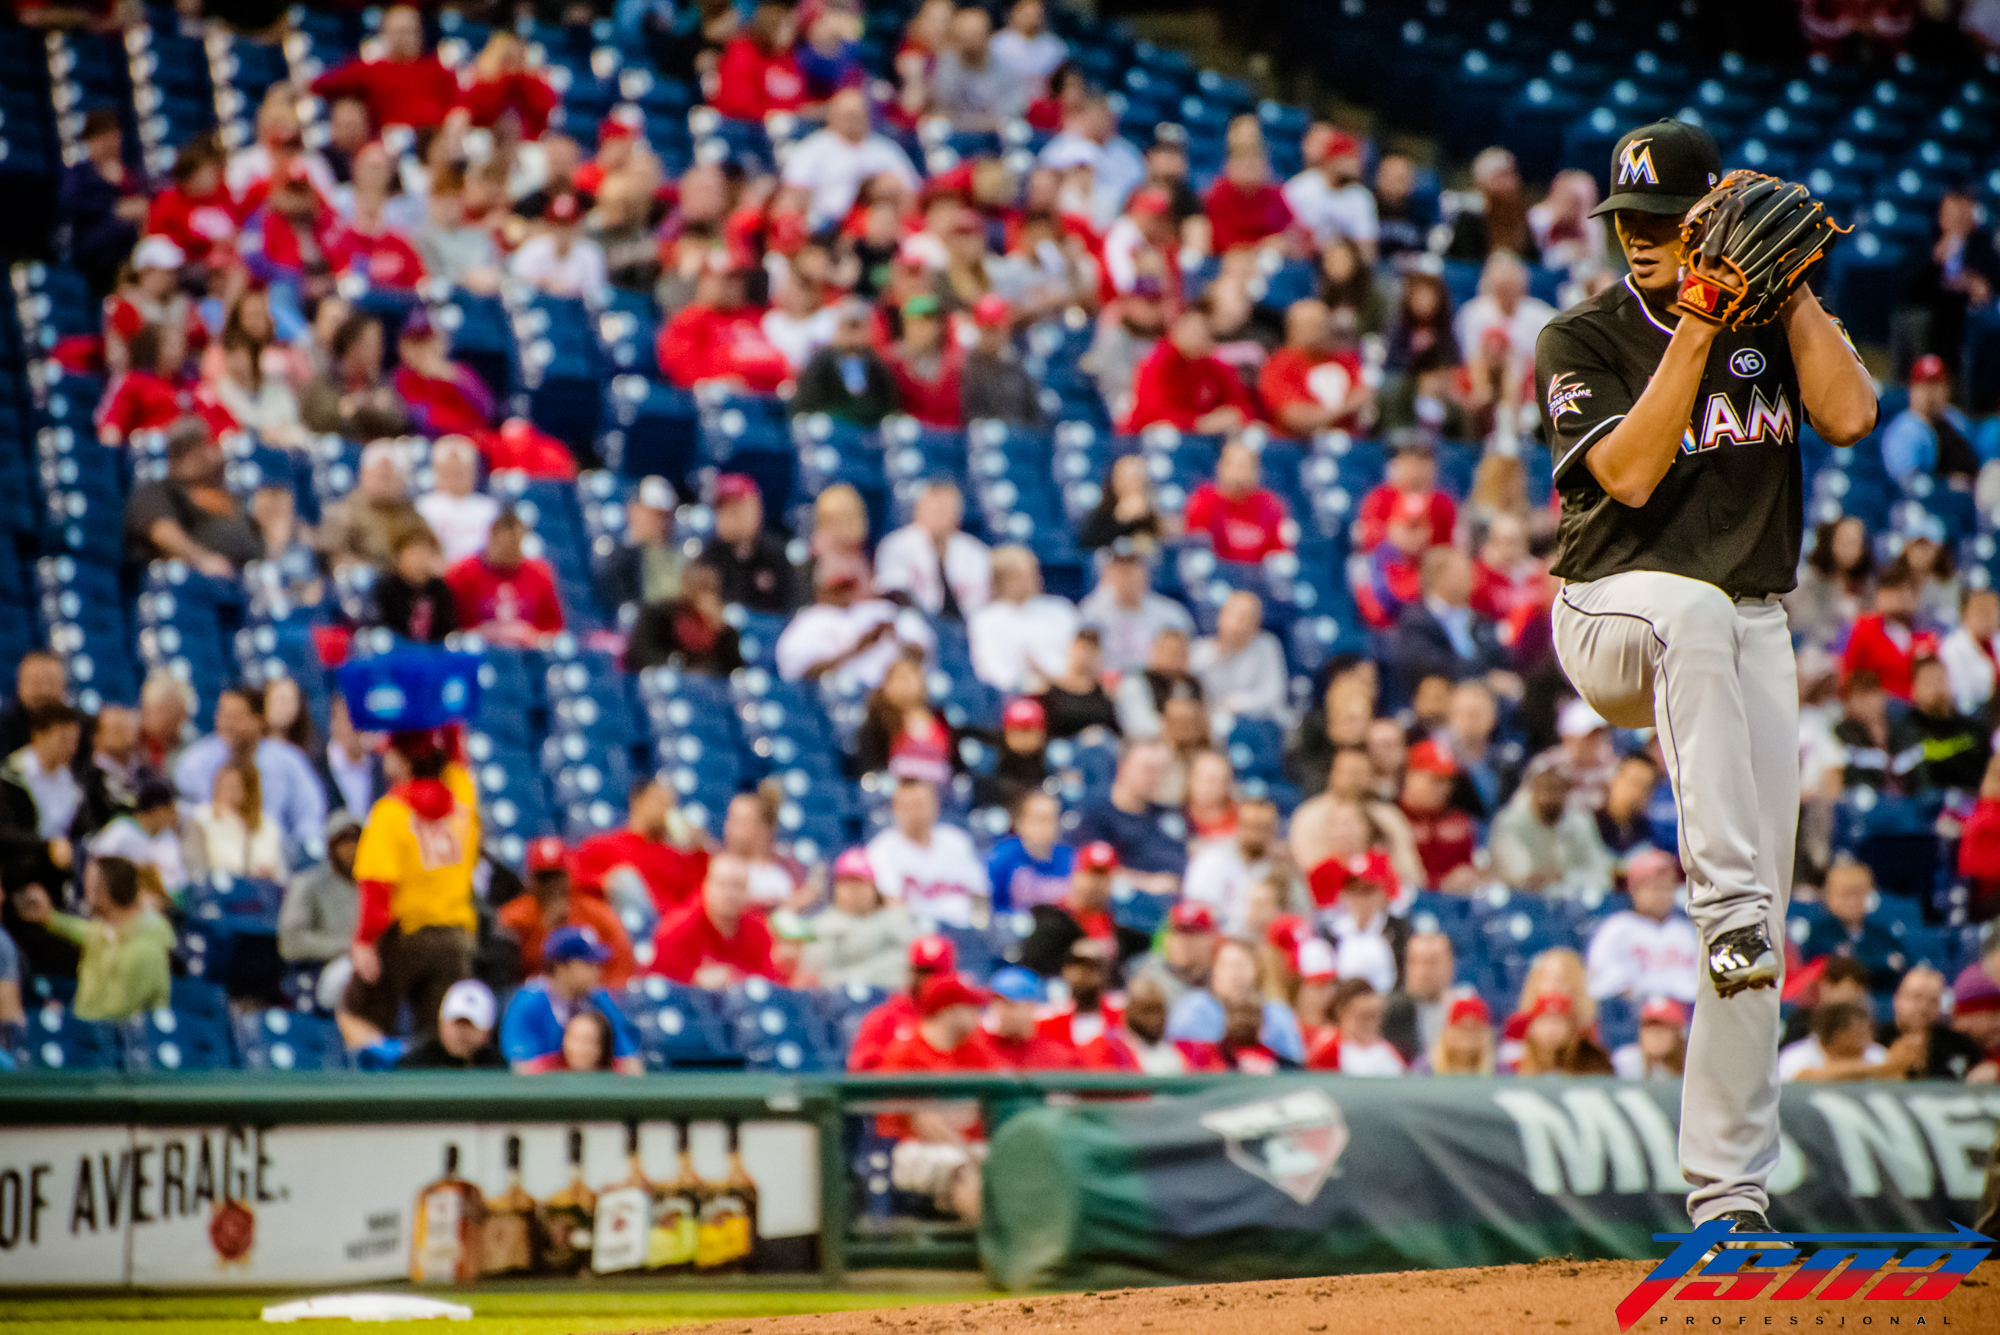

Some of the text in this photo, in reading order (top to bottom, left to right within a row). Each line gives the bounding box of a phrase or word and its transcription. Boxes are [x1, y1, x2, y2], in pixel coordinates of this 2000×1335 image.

[1564, 389, 1592, 401] GAME
[1734, 353, 1760, 372] 16
[1681, 383, 1794, 456] AM
[1494, 1088, 2000, 1199] ML NE
[0, 1164, 52, 1250] OF
